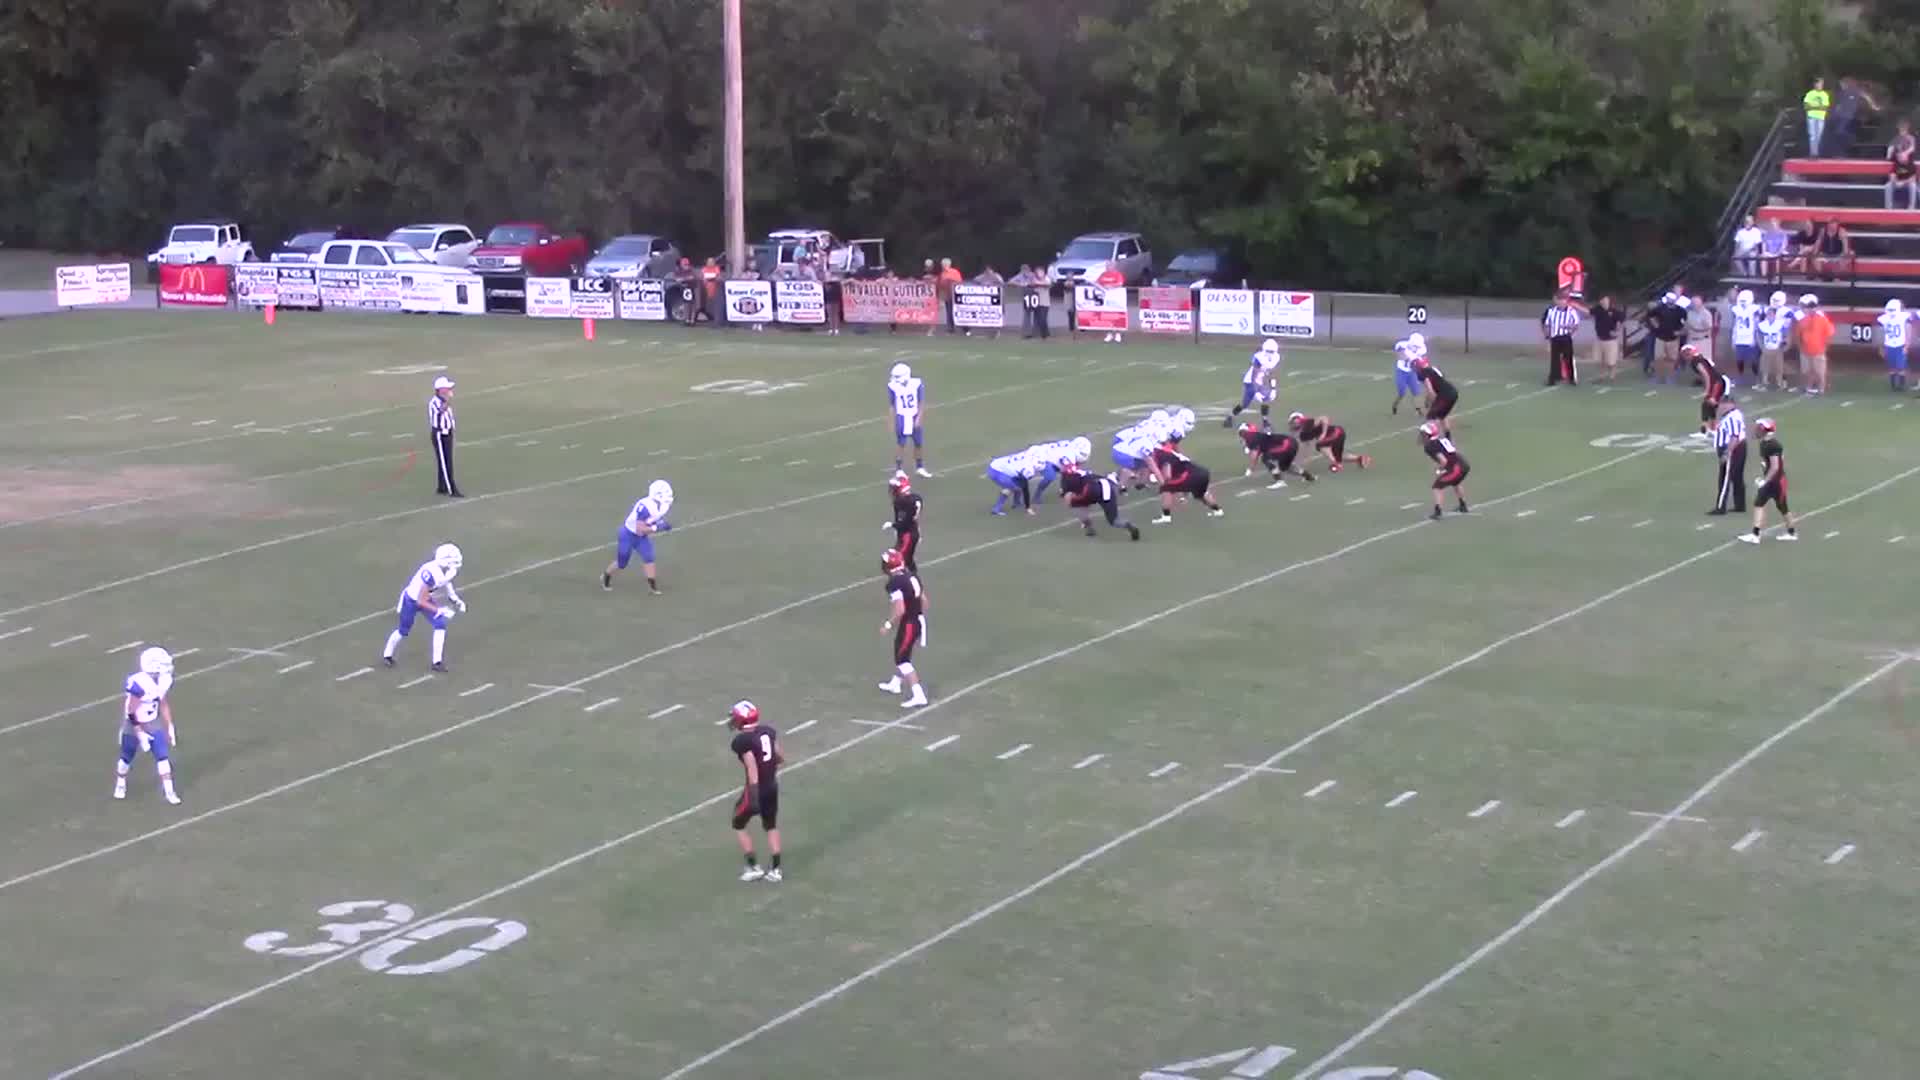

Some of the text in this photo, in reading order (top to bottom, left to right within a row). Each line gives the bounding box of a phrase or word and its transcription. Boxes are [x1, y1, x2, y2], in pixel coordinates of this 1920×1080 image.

[578, 278, 605, 292] ICC
[1024, 294, 1039, 308] 10
[1408, 306, 1427, 322] 20
[1852, 325, 1872, 341] 30
[900, 394, 914, 408] 12
[760, 734, 772, 762] 9
[243, 900, 528, 975] 30
